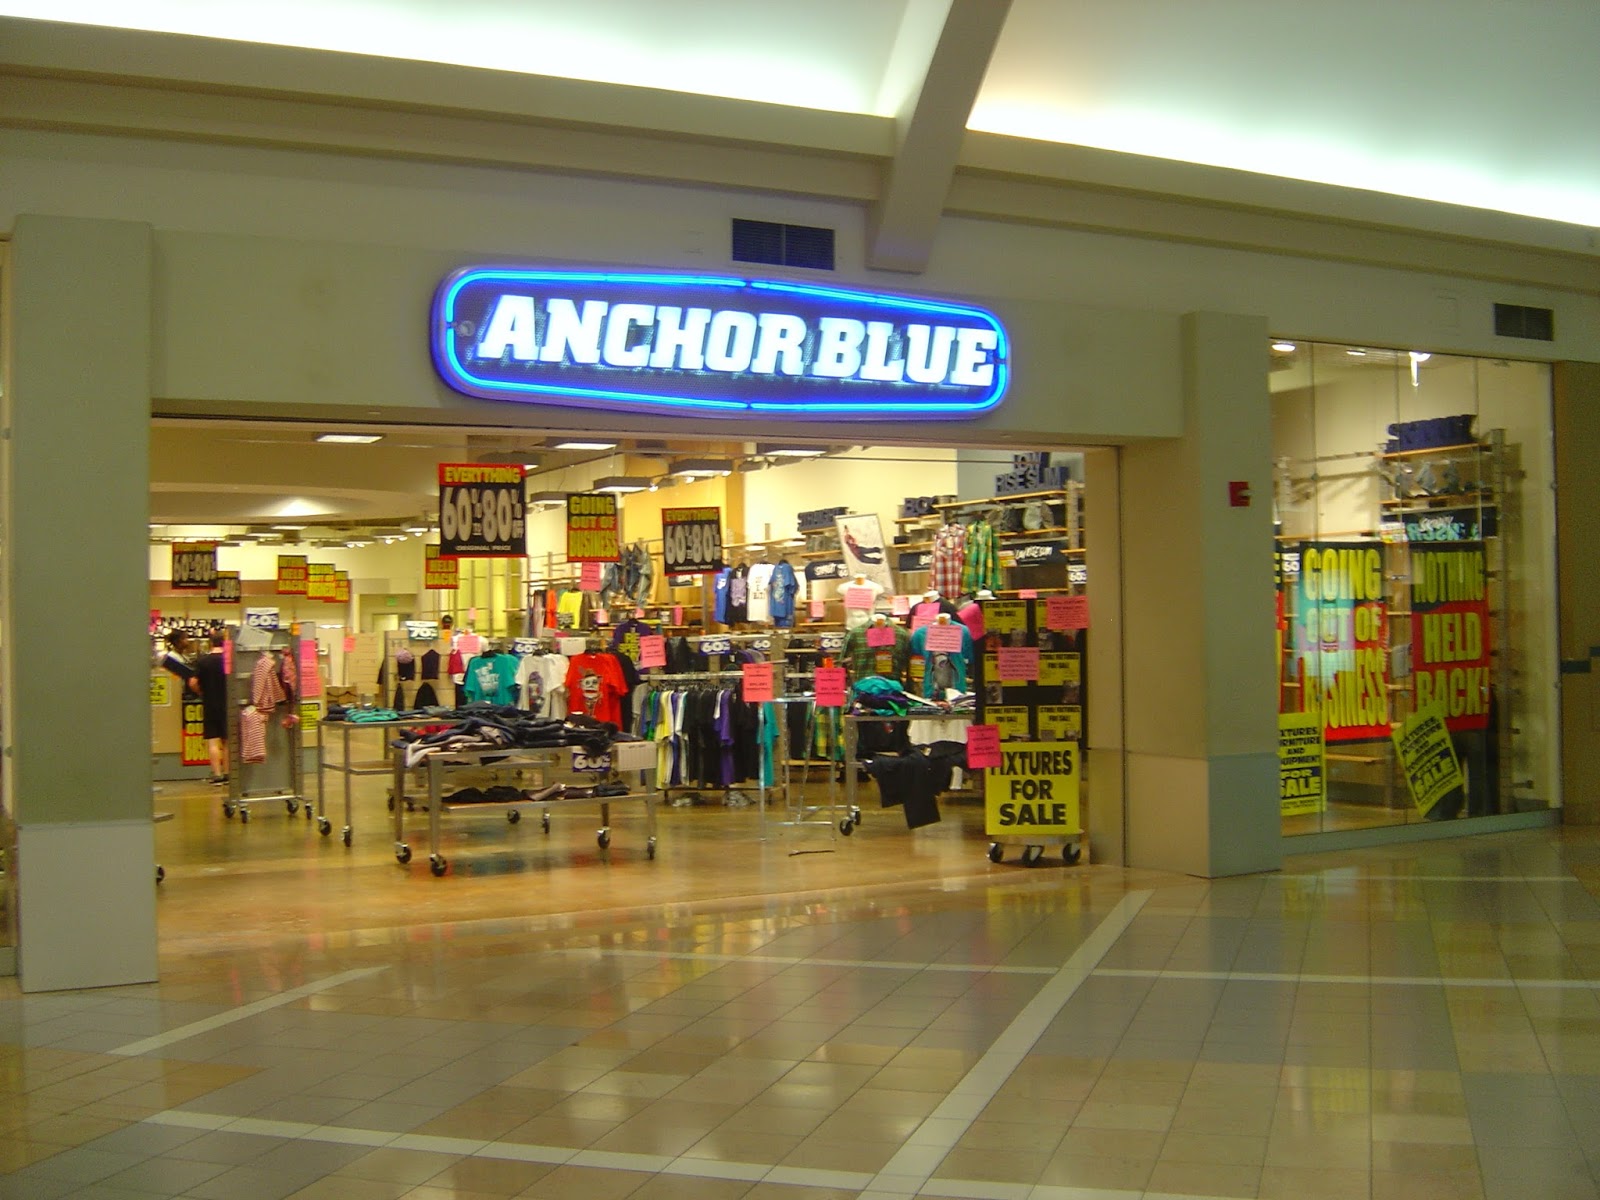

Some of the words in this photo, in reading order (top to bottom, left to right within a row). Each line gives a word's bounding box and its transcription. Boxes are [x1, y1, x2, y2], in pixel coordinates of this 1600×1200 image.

[476, 294, 810, 374] ANCHOR
[811, 316, 998, 388] BLUE
[444, 466, 521, 484] EVERYTHING
[569, 496, 615, 515] GOING
[568, 529, 619, 558] BUSINESS
[1303, 548, 1382, 601] GOING
[1412, 551, 1483, 603] NOTHING
[1305, 607, 1351, 643] OUT
[1355, 606, 1383, 641] OF
[1422, 612, 1483, 663] HELD
[1281, 727, 1317, 737] XTURES
[990, 750, 1073, 776] IXTURES
[1010, 780, 1053, 801] FOR
[999, 803, 1066, 826] SALE
